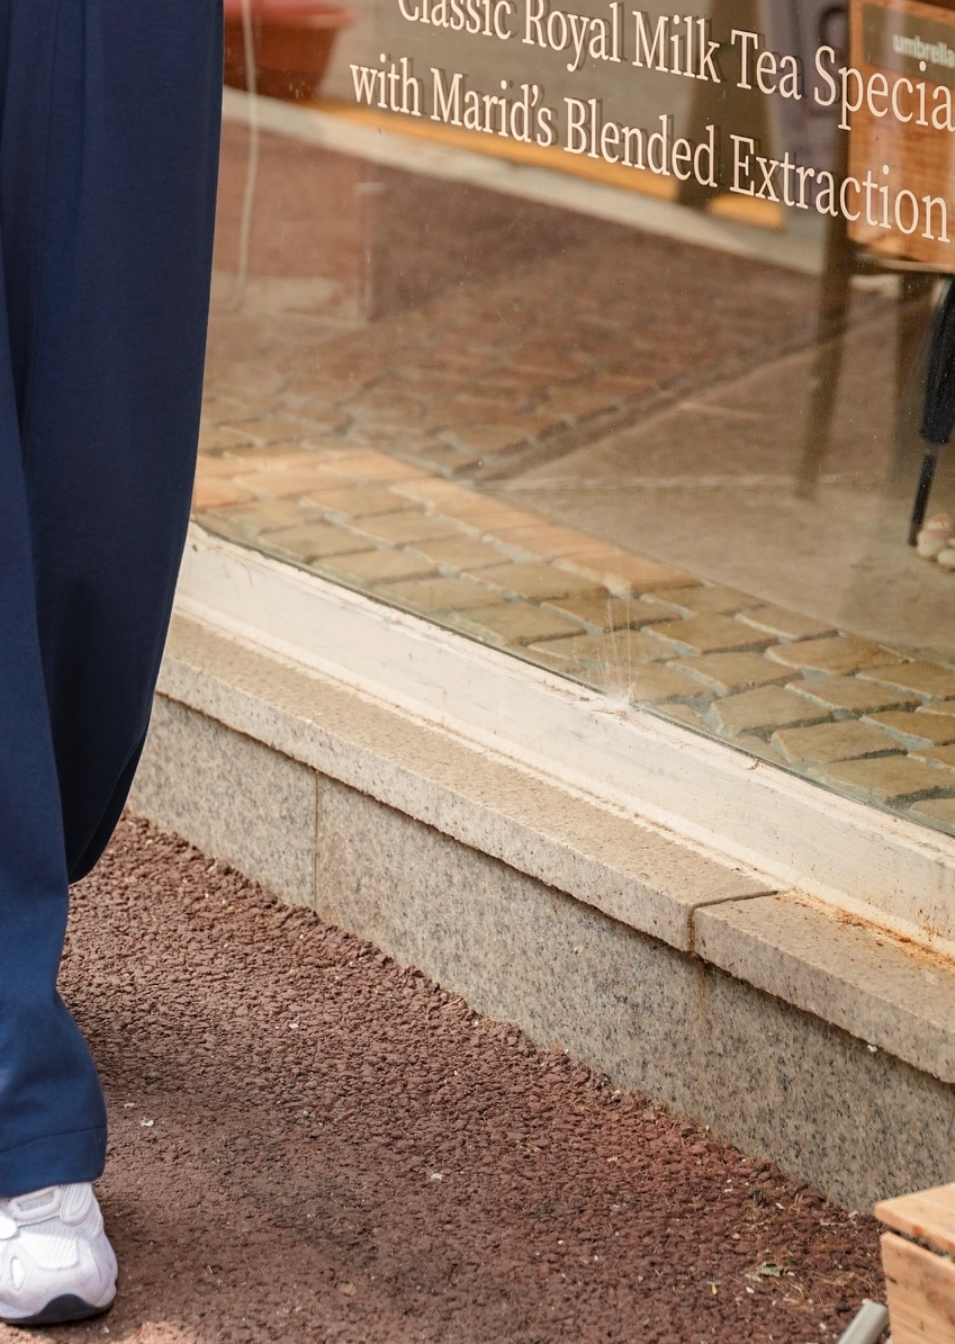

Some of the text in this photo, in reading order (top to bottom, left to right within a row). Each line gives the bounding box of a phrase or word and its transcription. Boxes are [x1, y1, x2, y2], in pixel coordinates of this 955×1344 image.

[632, 11, 721, 84] Milk
[730, 29, 802, 101] Tea
[349, 52, 951, 244] with Marid's Blended Extraction
